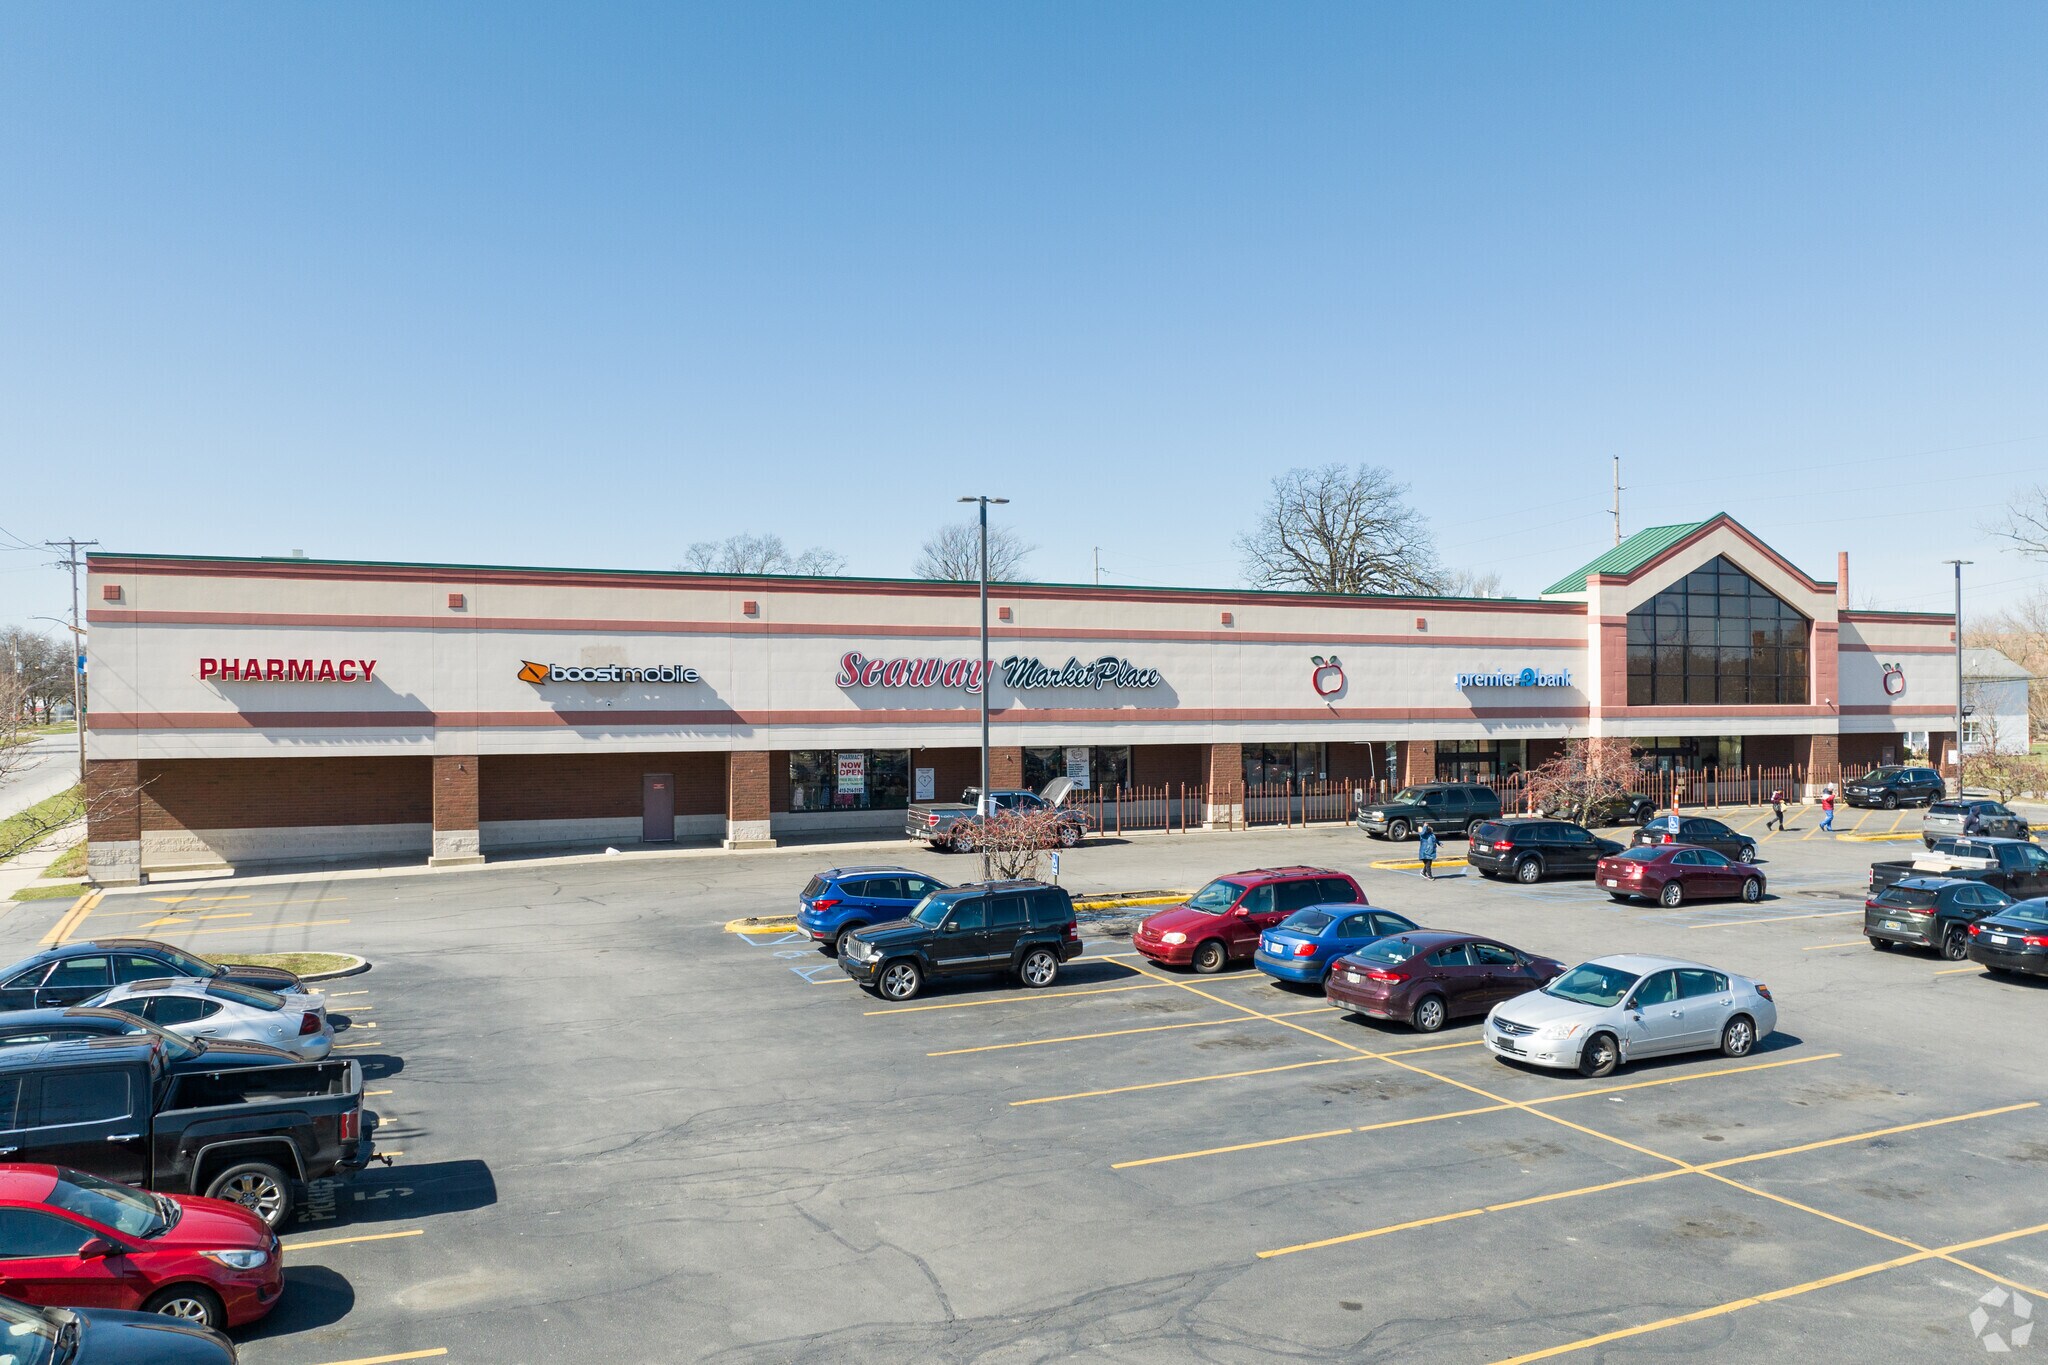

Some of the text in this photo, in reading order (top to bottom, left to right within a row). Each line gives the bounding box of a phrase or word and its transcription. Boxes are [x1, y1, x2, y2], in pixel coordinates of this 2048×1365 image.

[199, 657, 378, 683] PHARMACY
[835, 650, 996, 693] Seaway
[1455, 668, 1574, 692] premier bank
[296, 1179, 345, 1223] Pickup
